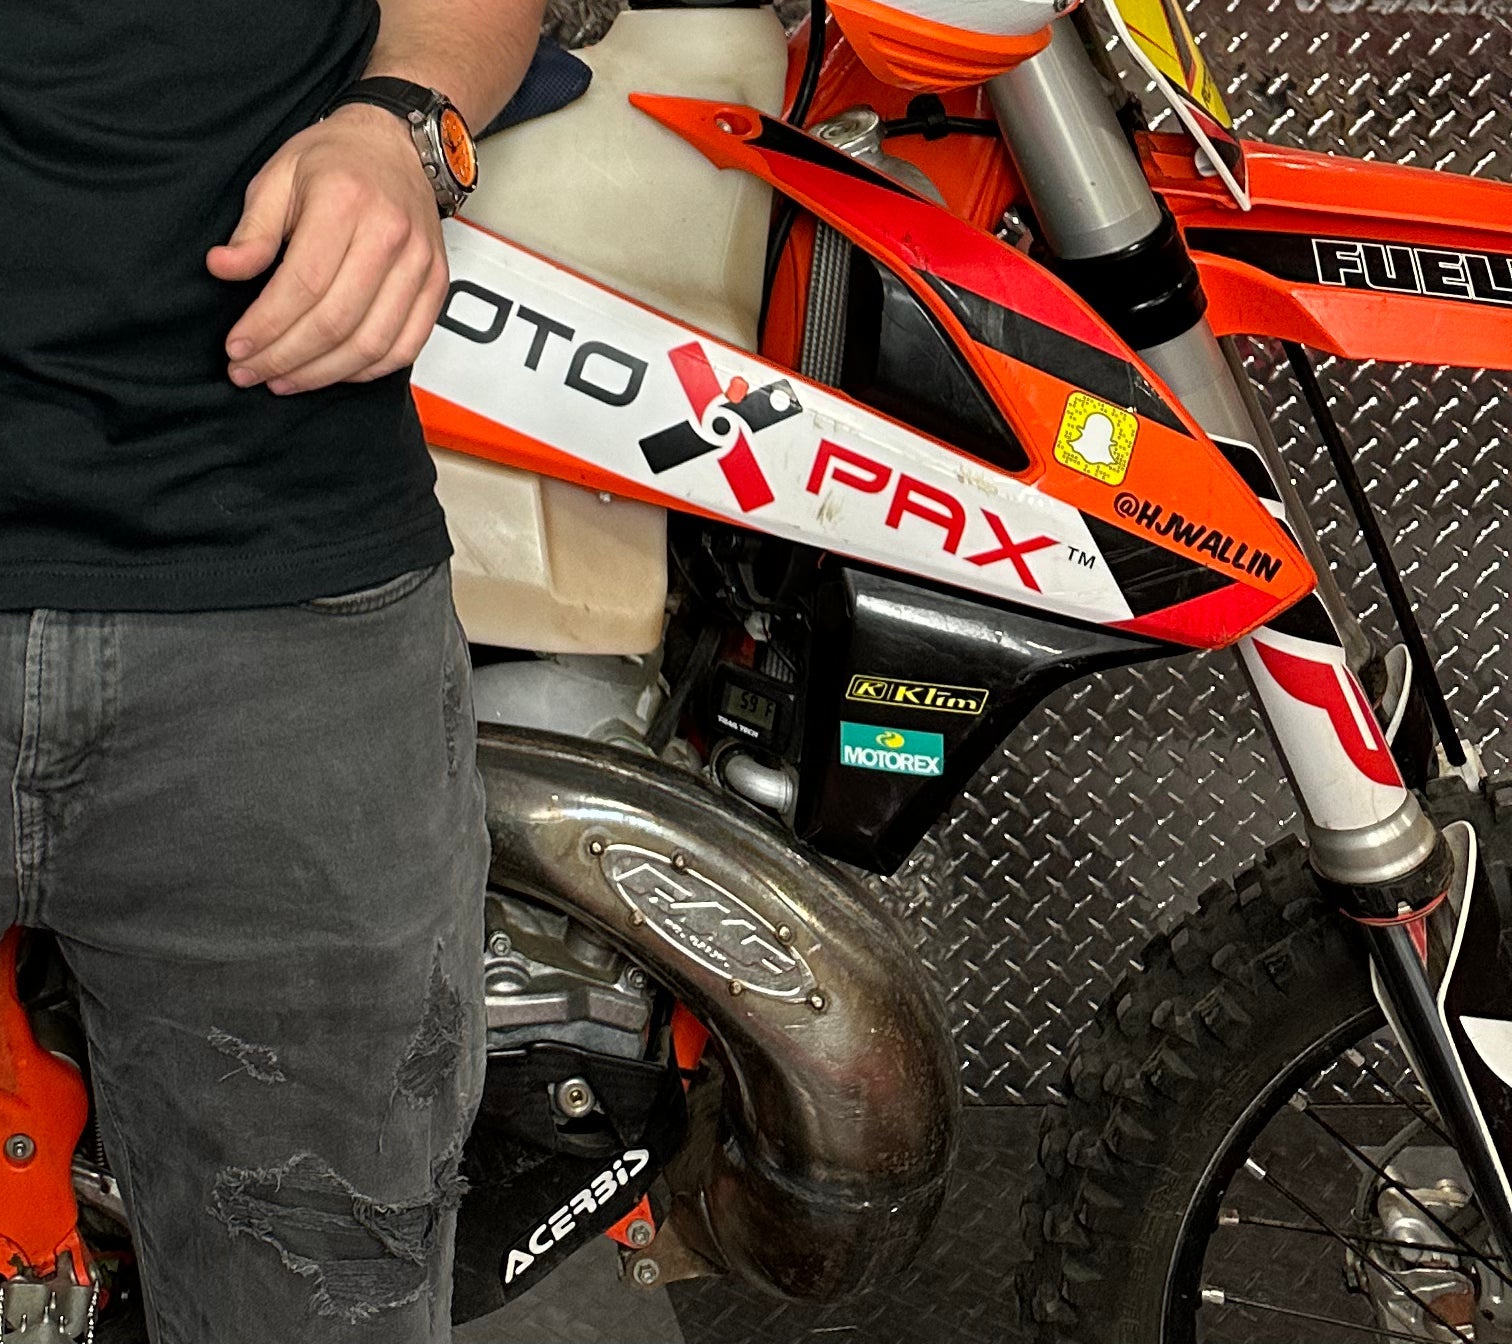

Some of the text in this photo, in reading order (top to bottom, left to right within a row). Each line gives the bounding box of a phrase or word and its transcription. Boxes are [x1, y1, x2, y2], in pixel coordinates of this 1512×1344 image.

[1311, 238, 1512, 305] FUEL
[1113, 491, 1283, 583] @HJWALLIN
[740, 692, 759, 713] 59
[894, 687, 978, 711] Klim
[844, 745, 941, 774] MOTOREX
